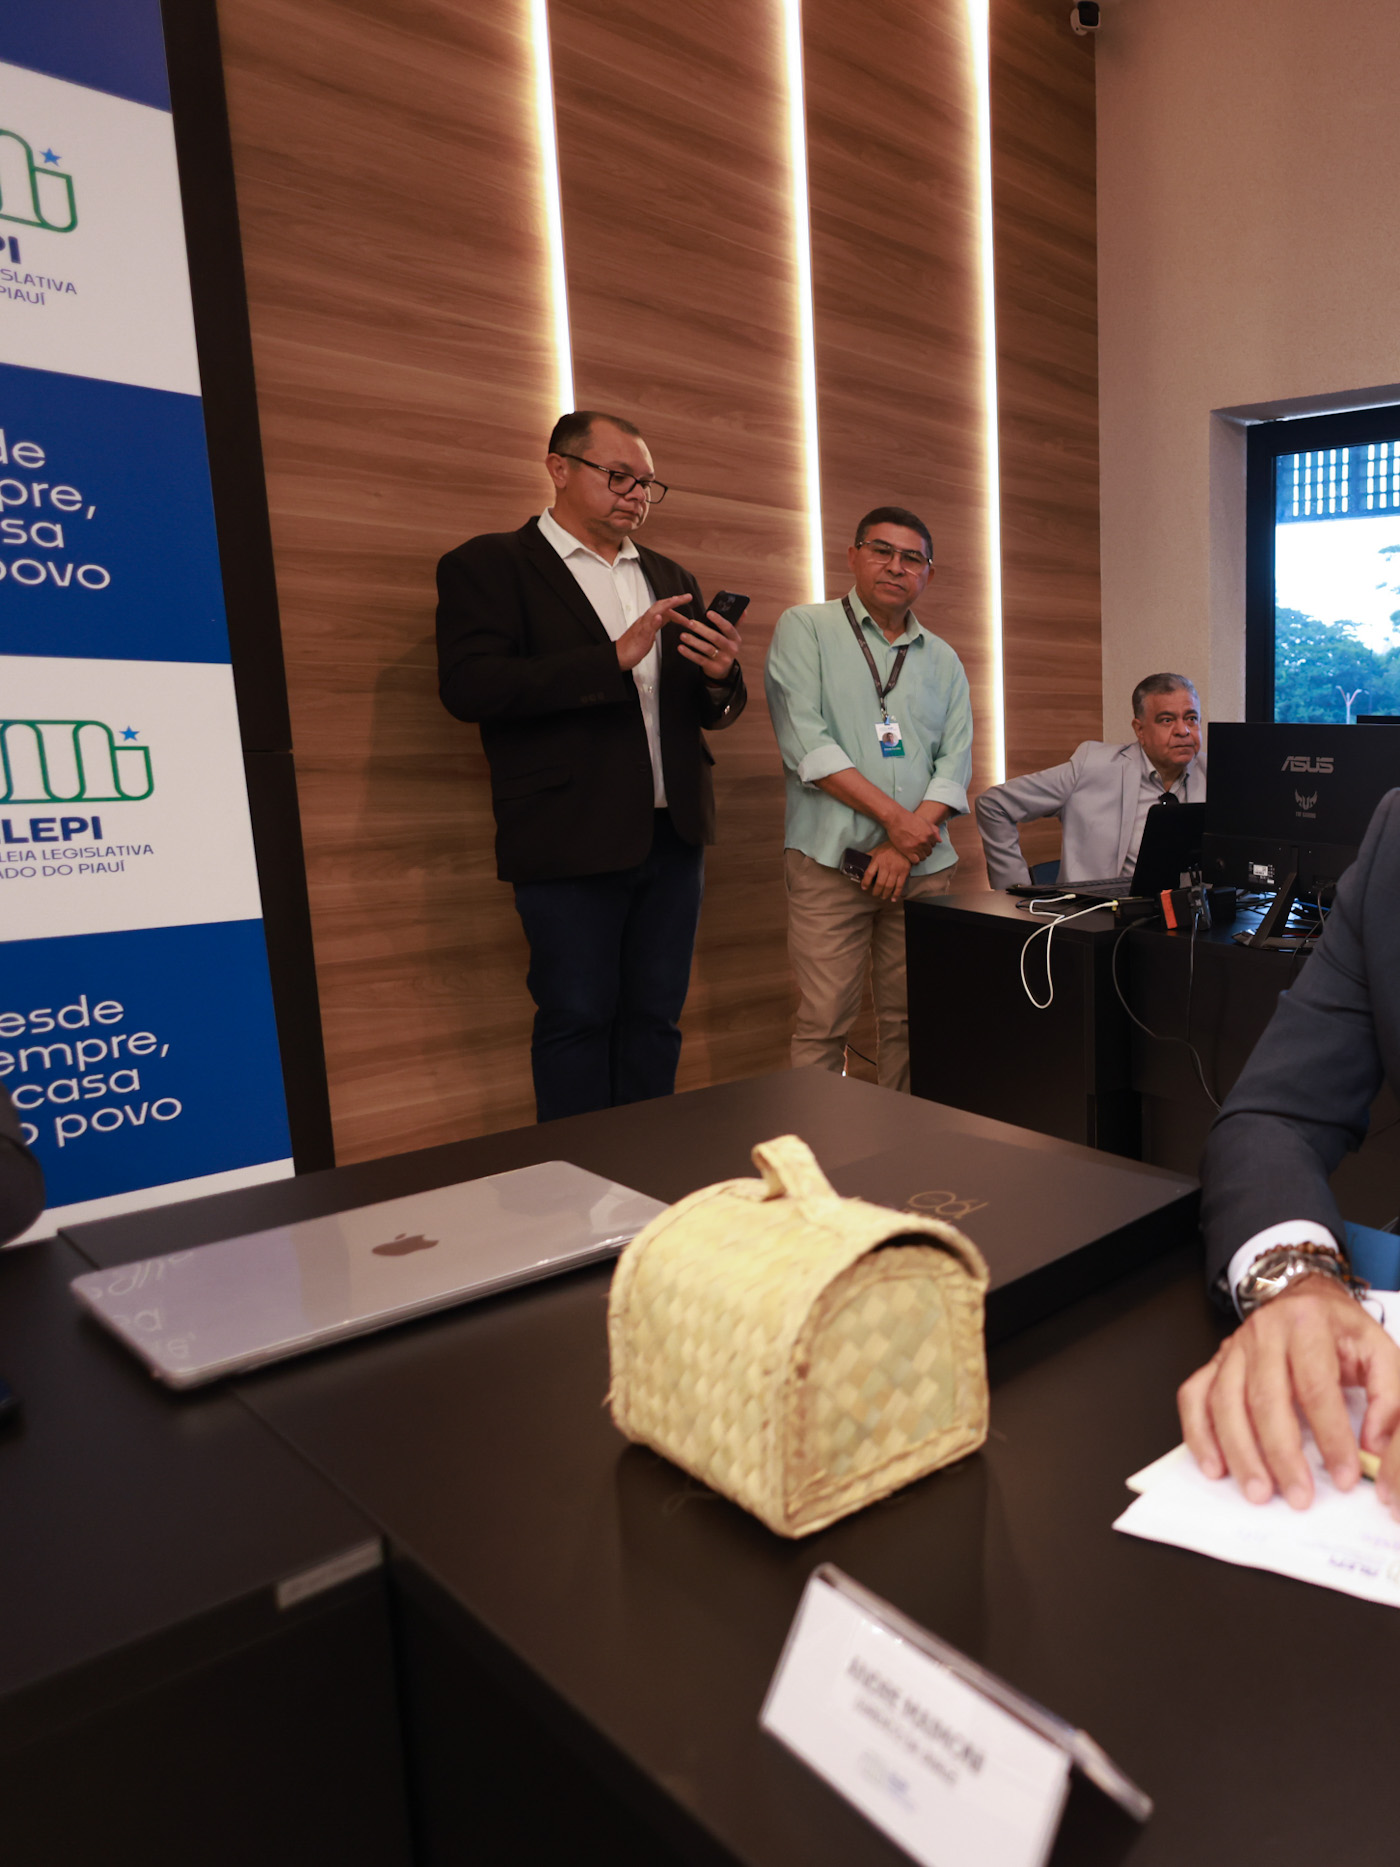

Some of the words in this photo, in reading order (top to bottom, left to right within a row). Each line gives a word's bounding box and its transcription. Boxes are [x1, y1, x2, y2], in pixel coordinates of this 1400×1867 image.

[1, 519, 65, 548] sa
[0, 559, 110, 589] ovo
[1281, 755, 1335, 774] ASUS
[0, 815, 103, 845] LEPI
[42, 844, 154, 861] LEGISLATIVA
[42, 864, 73, 877] DO
[79, 859, 125, 874] PIAUÍ
[11, 1068, 141, 1109] casa
[55, 1097, 183, 1148] povo
